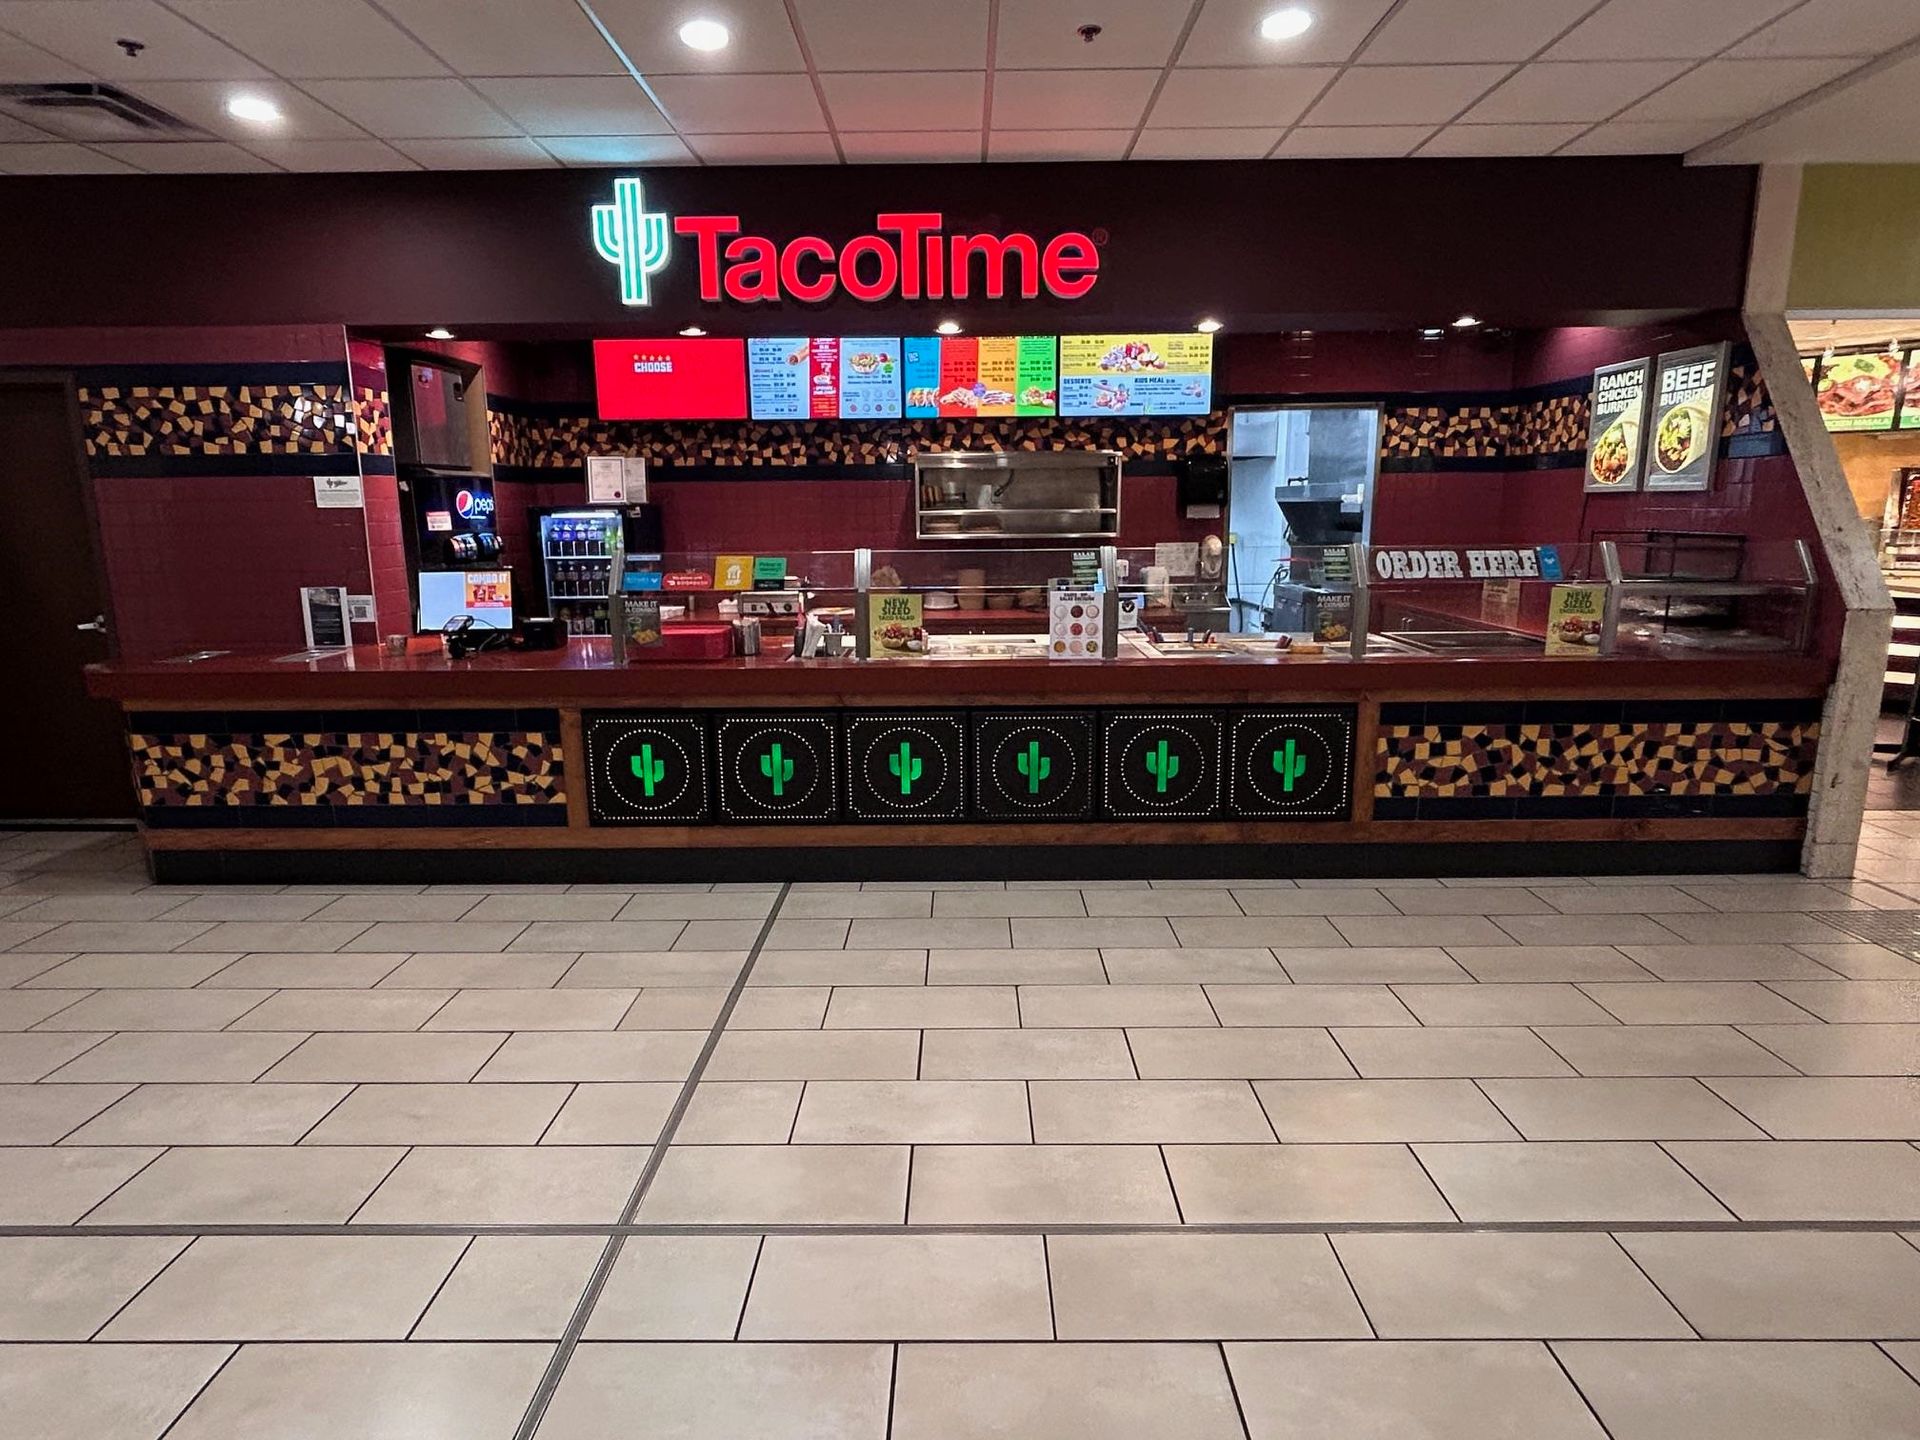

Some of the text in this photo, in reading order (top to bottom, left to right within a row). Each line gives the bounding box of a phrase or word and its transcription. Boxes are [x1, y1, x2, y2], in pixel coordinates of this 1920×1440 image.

[674, 213, 1100, 302] TacoTime
[633, 362, 673, 373] CHOOSE
[1599, 369, 1645, 391] RANCH
[1661, 361, 1717, 393] BEEF
[1375, 550, 1464, 580] ORDER
[1466, 549, 1540, 578] HERE
[467, 573, 509, 584] COMBO IT
[1317, 594, 1352, 602] MAKE IT
[1566, 591, 1593, 601] NEW
[624, 600, 658, 608] MAKE IT
[883, 597, 910, 608] NEW
[1563, 599, 1593, 609] SIZED
[881, 606, 911, 616] SIZED
